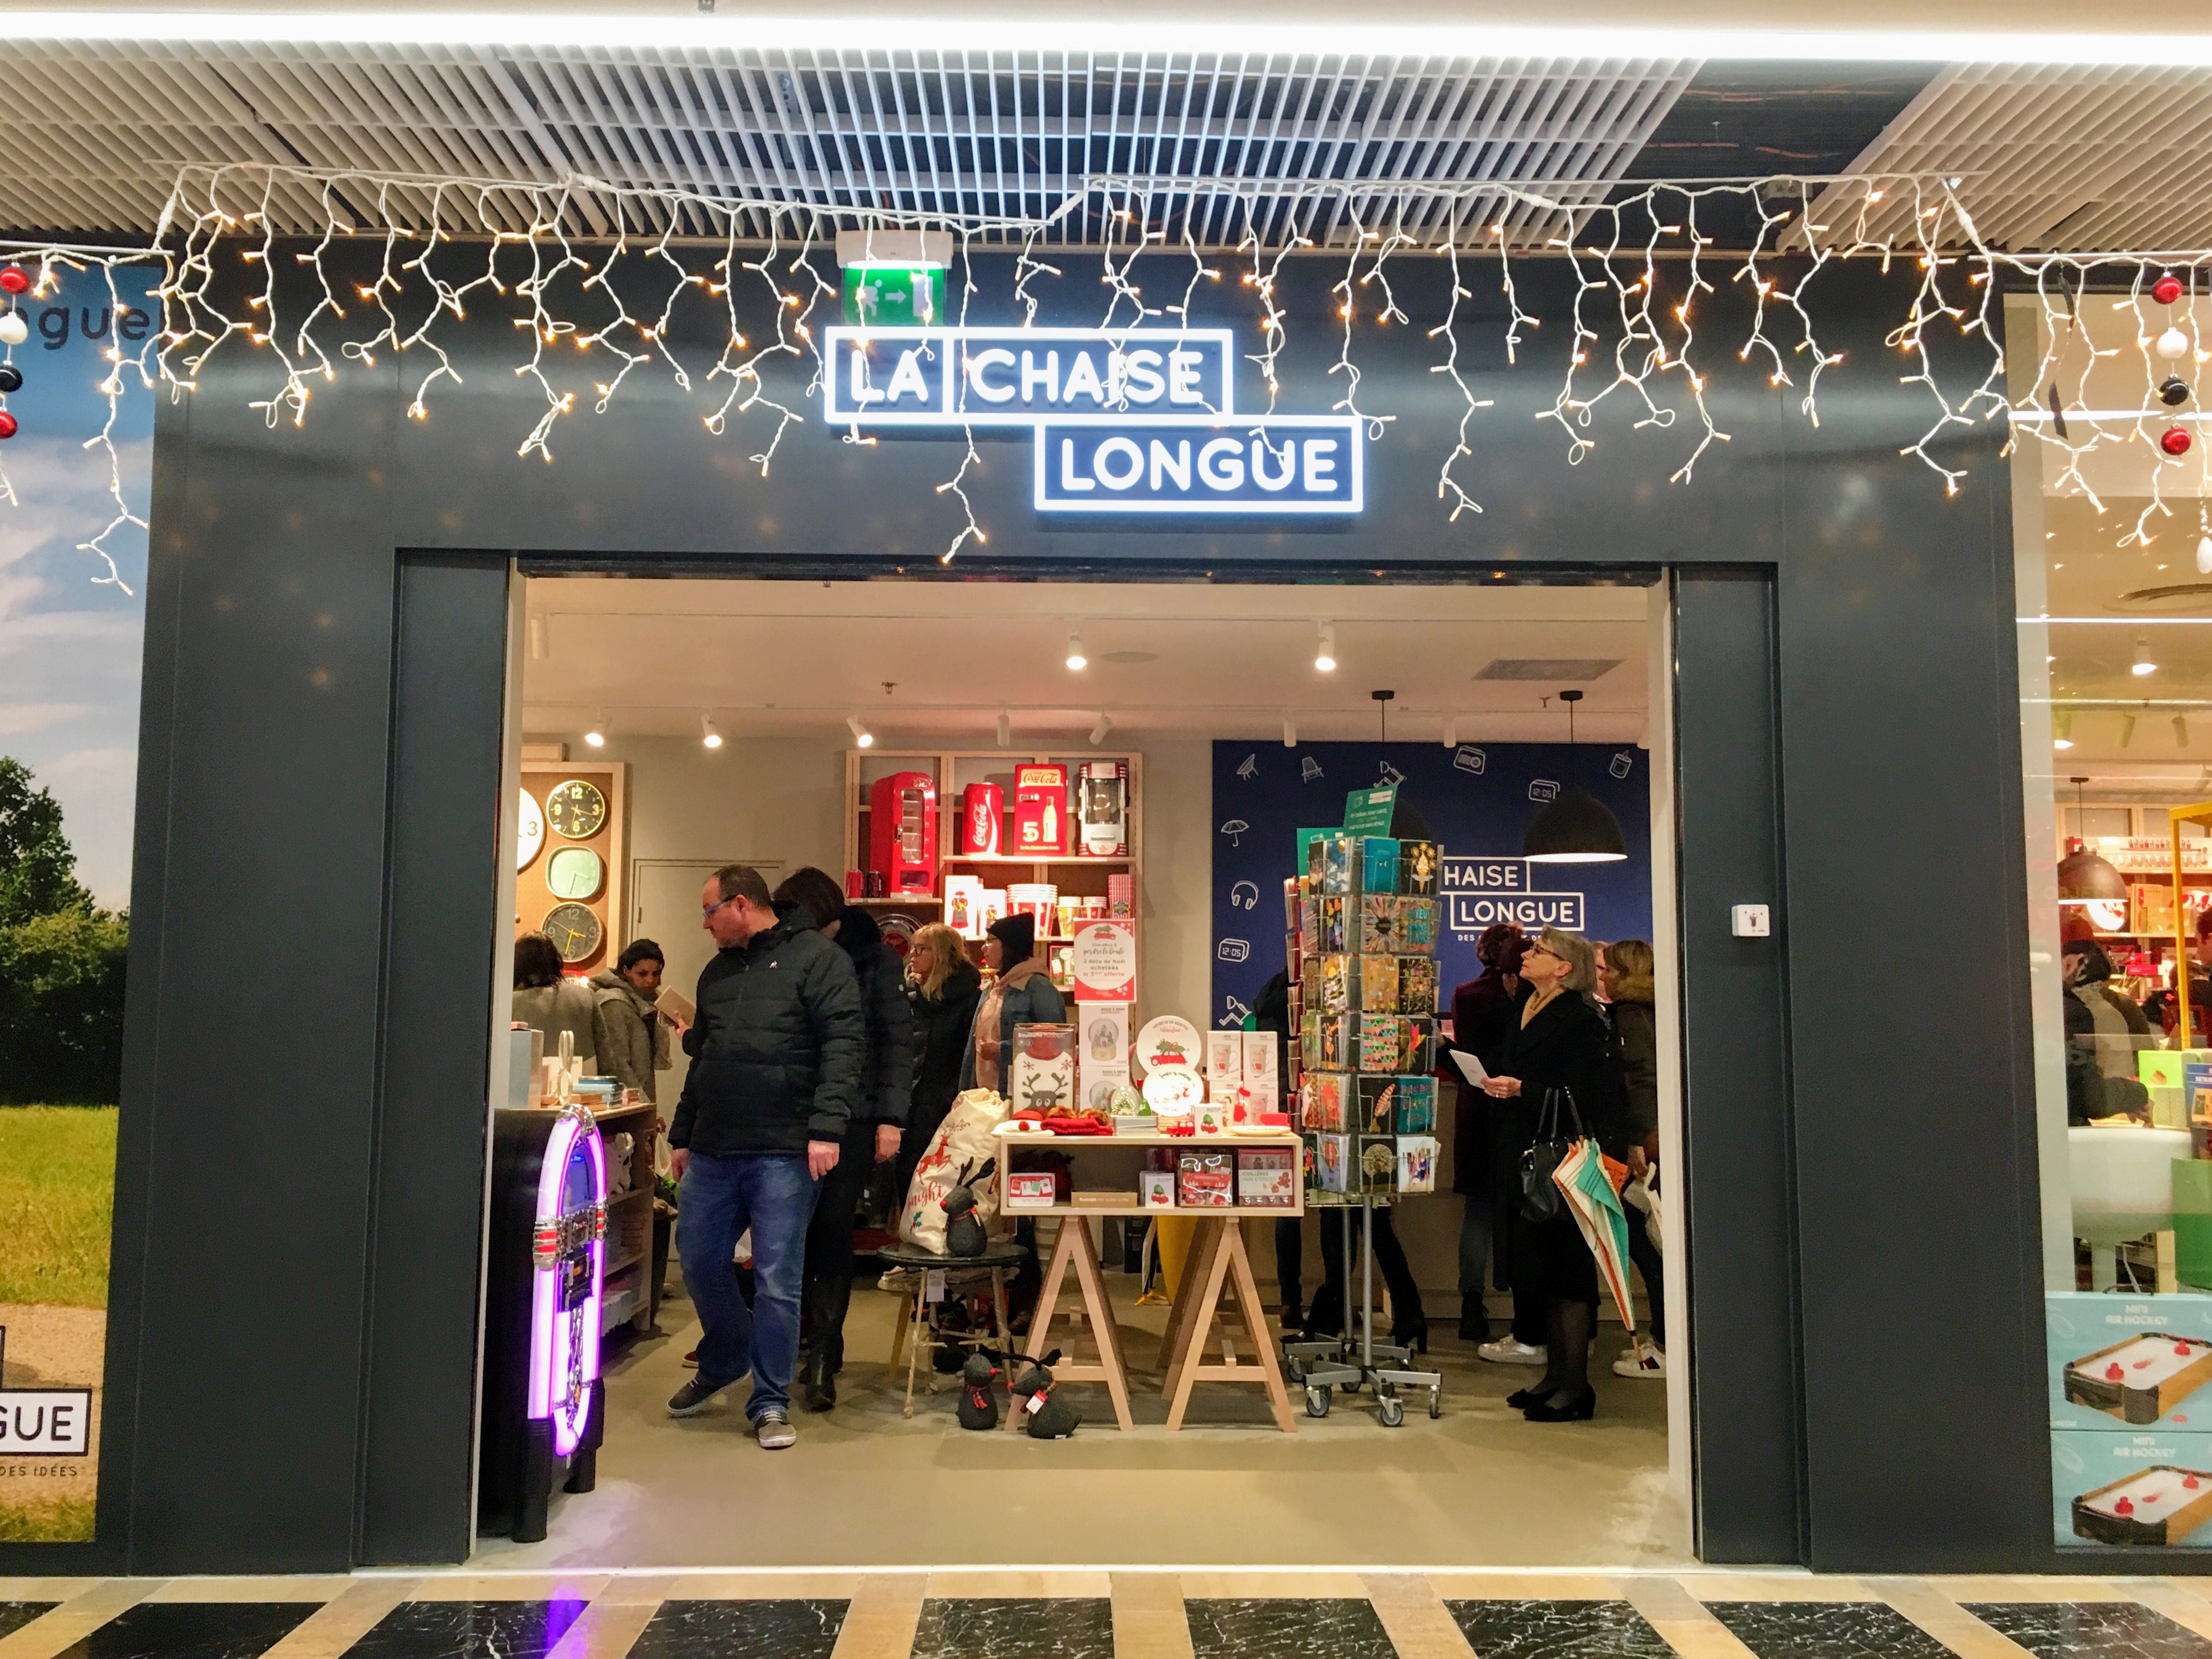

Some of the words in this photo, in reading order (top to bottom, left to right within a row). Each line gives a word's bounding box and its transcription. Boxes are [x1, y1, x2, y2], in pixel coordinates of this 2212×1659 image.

[850, 350, 928, 402] LA
[968, 349, 1205, 405] CHAISE
[1061, 437, 1339, 492] LONGUE
[527, 821, 538, 836] 3
[1022, 821, 1039, 843] 5
[1444, 865, 1519, 887] HAISE
[567, 909, 579, 920] 12
[1461, 900, 1574, 923] LONGUE
[589, 926, 597, 938] 3
[1222, 947, 1241, 957] 12:05
[2105, 1315, 2122, 1324] AIR
[2124, 1315, 2168, 1325] HOCKEY
[0, 1406, 74, 1441] UE
[2113, 1447, 2130, 1457] AIR
[2133, 1447, 2176, 1458] HOCKEY
[33, 1463, 77, 1476] IDÉES
